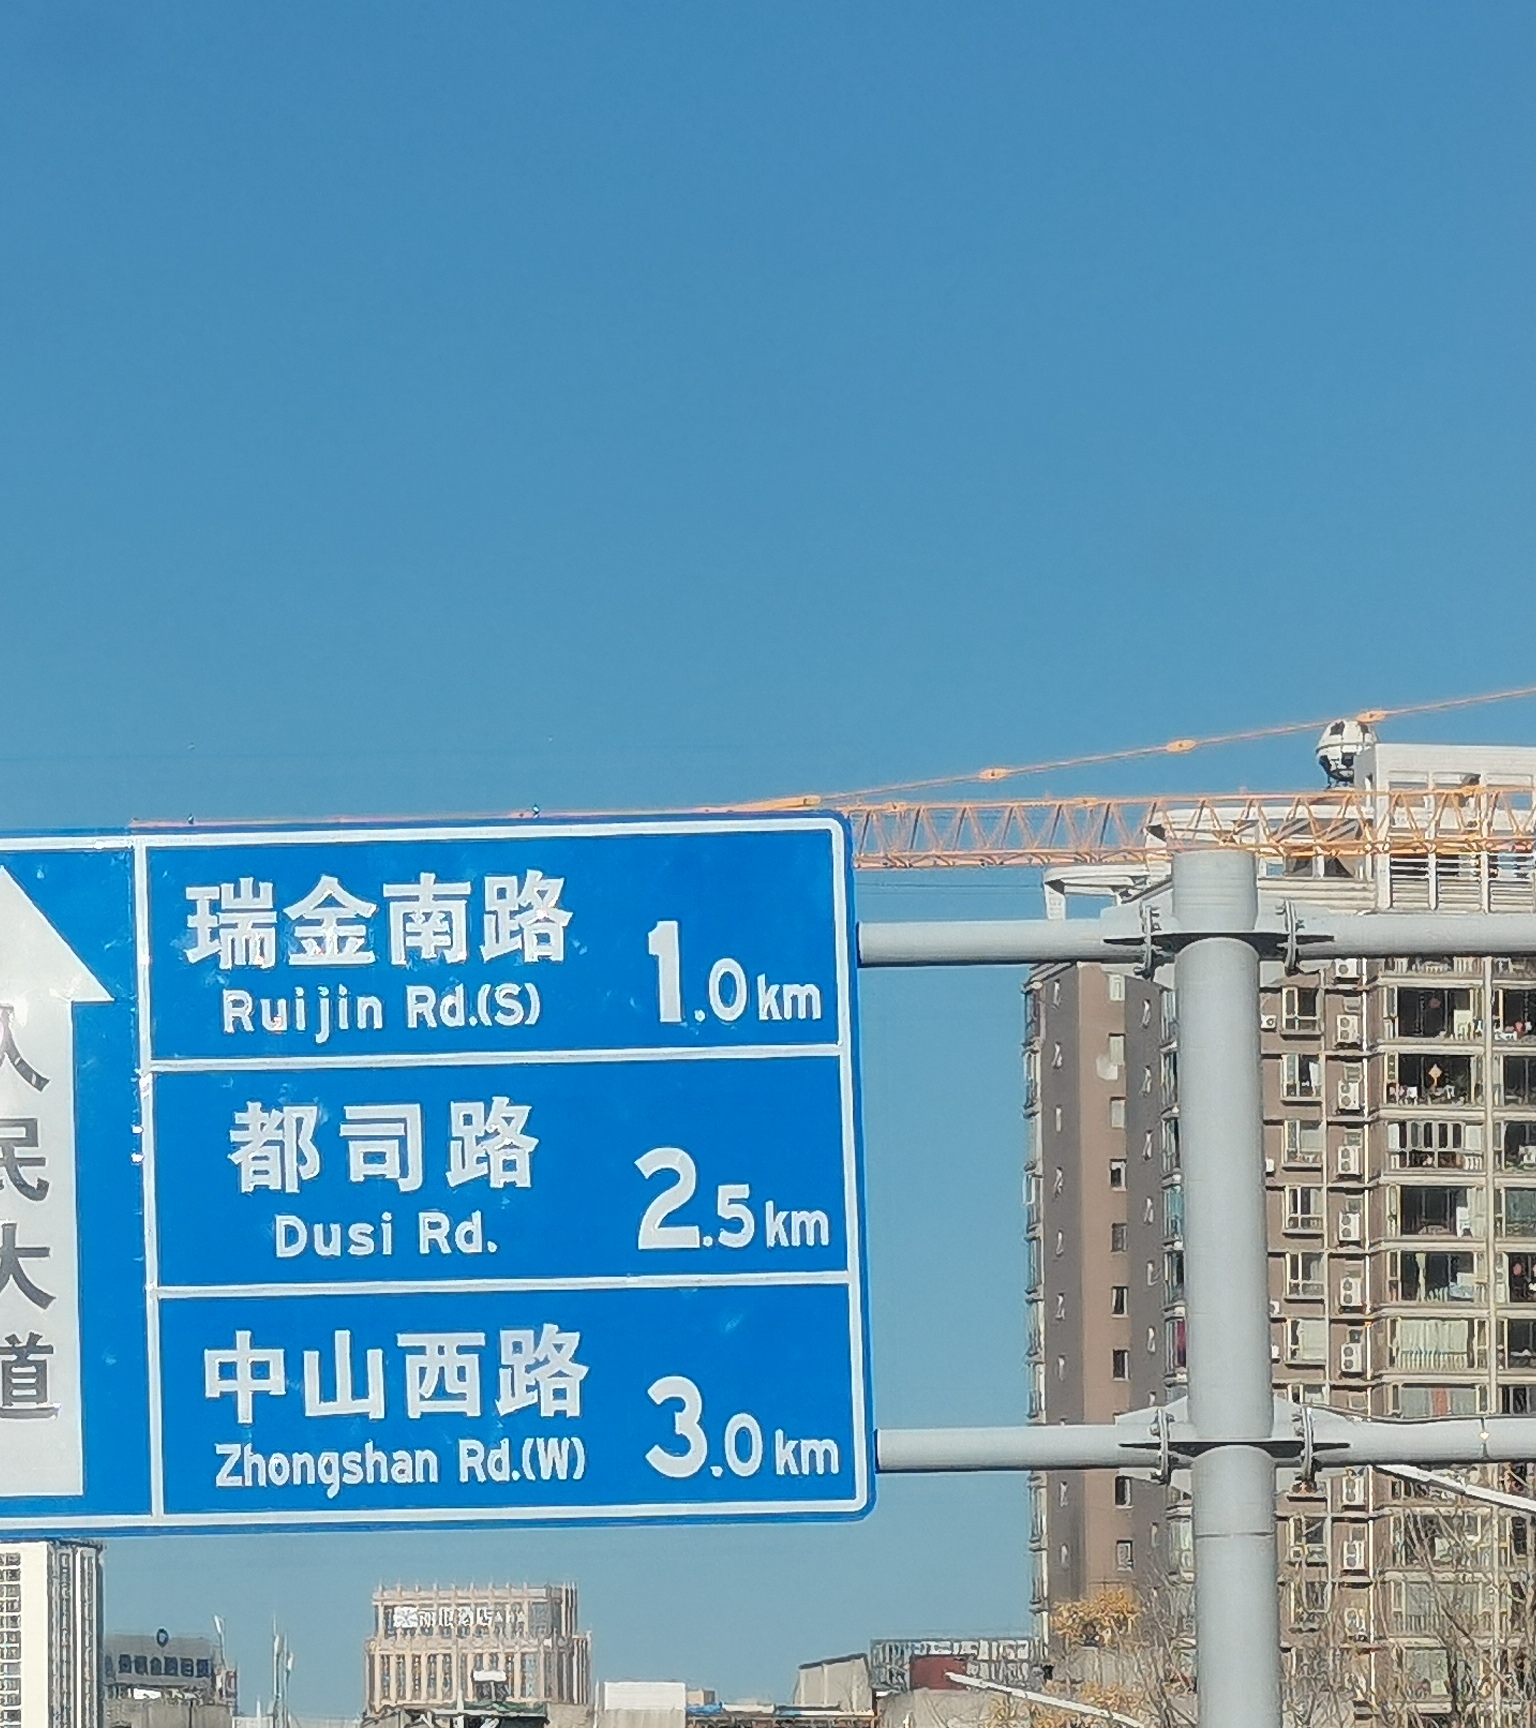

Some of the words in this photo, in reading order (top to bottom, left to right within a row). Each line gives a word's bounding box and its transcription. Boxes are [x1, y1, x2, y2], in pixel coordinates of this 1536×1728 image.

[184, 868, 574, 970] 瑞金南路
[221, 984, 384, 1045] Ruijin
[406, 982, 543, 1030] Rd.(S)
[227, 1095, 540, 1194] 都司路
[274, 1211, 393, 1258] Dusi
[418, 1210, 499, 1255] Rd.
[203, 1323, 590, 1424] 中山西路
[214, 1440, 440, 1500] Zhongshan
[458, 1437, 588, 1485] Rd.(W)
